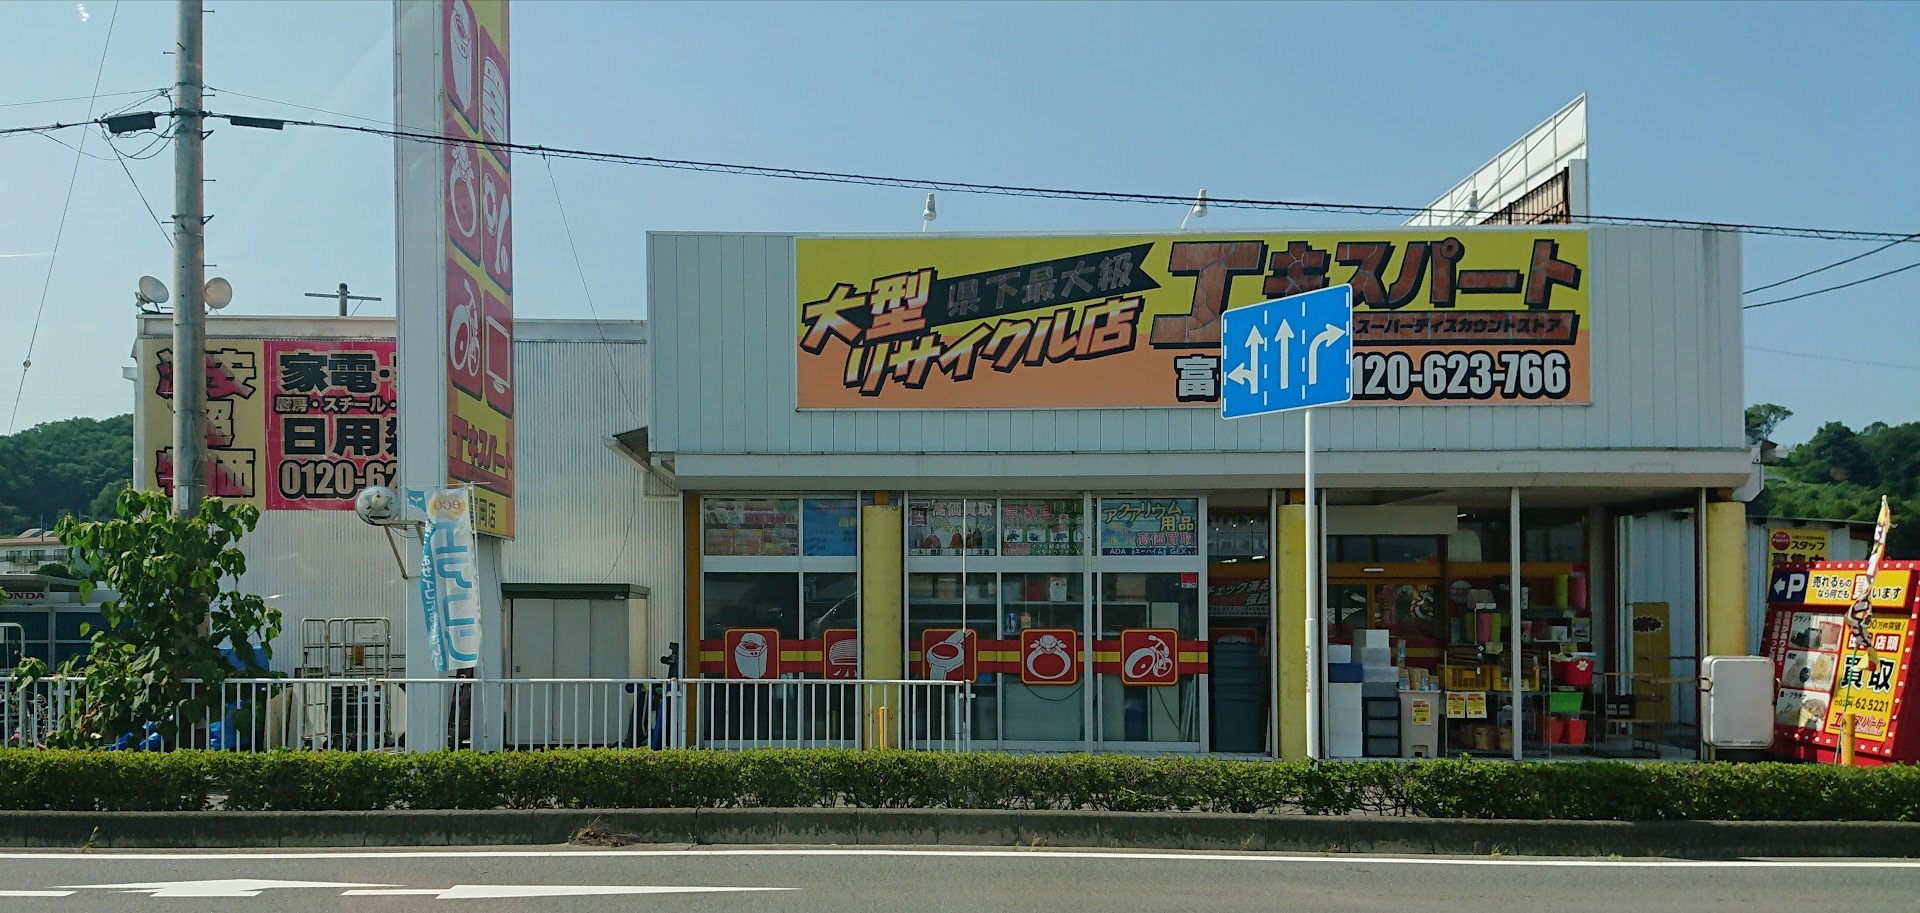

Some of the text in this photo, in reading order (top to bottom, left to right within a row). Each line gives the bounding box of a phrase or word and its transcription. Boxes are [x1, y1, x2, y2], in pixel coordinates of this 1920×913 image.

[947, 252, 1134, 317] 県下最大級
[1150, 237, 1580, 347] エキスパート
[800, 267, 937, 356] 大型
[1353, 317, 1562, 336] スーパーディスカウントストア
[843, 296, 1144, 397] リサイクル店
[156, 347, 256, 401] 安
[278, 350, 396, 395] 家電・
[1353, 353, 1569, 397] 120-623-766
[452, 414, 513, 480] エキスパート
[931, 501, 993, 527] 高価買取
[1003, 503, 1055, 523] 農機具
[1103, 500, 1183, 525] アクアリウム
[1160, 515, 1196, 532] 用品
[1136, 531, 1196, 547] 高価買取
[1791, 540, 1825, 552] スタッフ
[1786, 573, 1806, 600] P
[1812, 576, 1852, 589] 売れるもの
[1817, 589, 1850, 600] なら何でも
[1875, 634, 1900, 651] 店頭
[1840, 656, 1896, 692] 買取
[1829, 712, 1886, 730] エスパート
